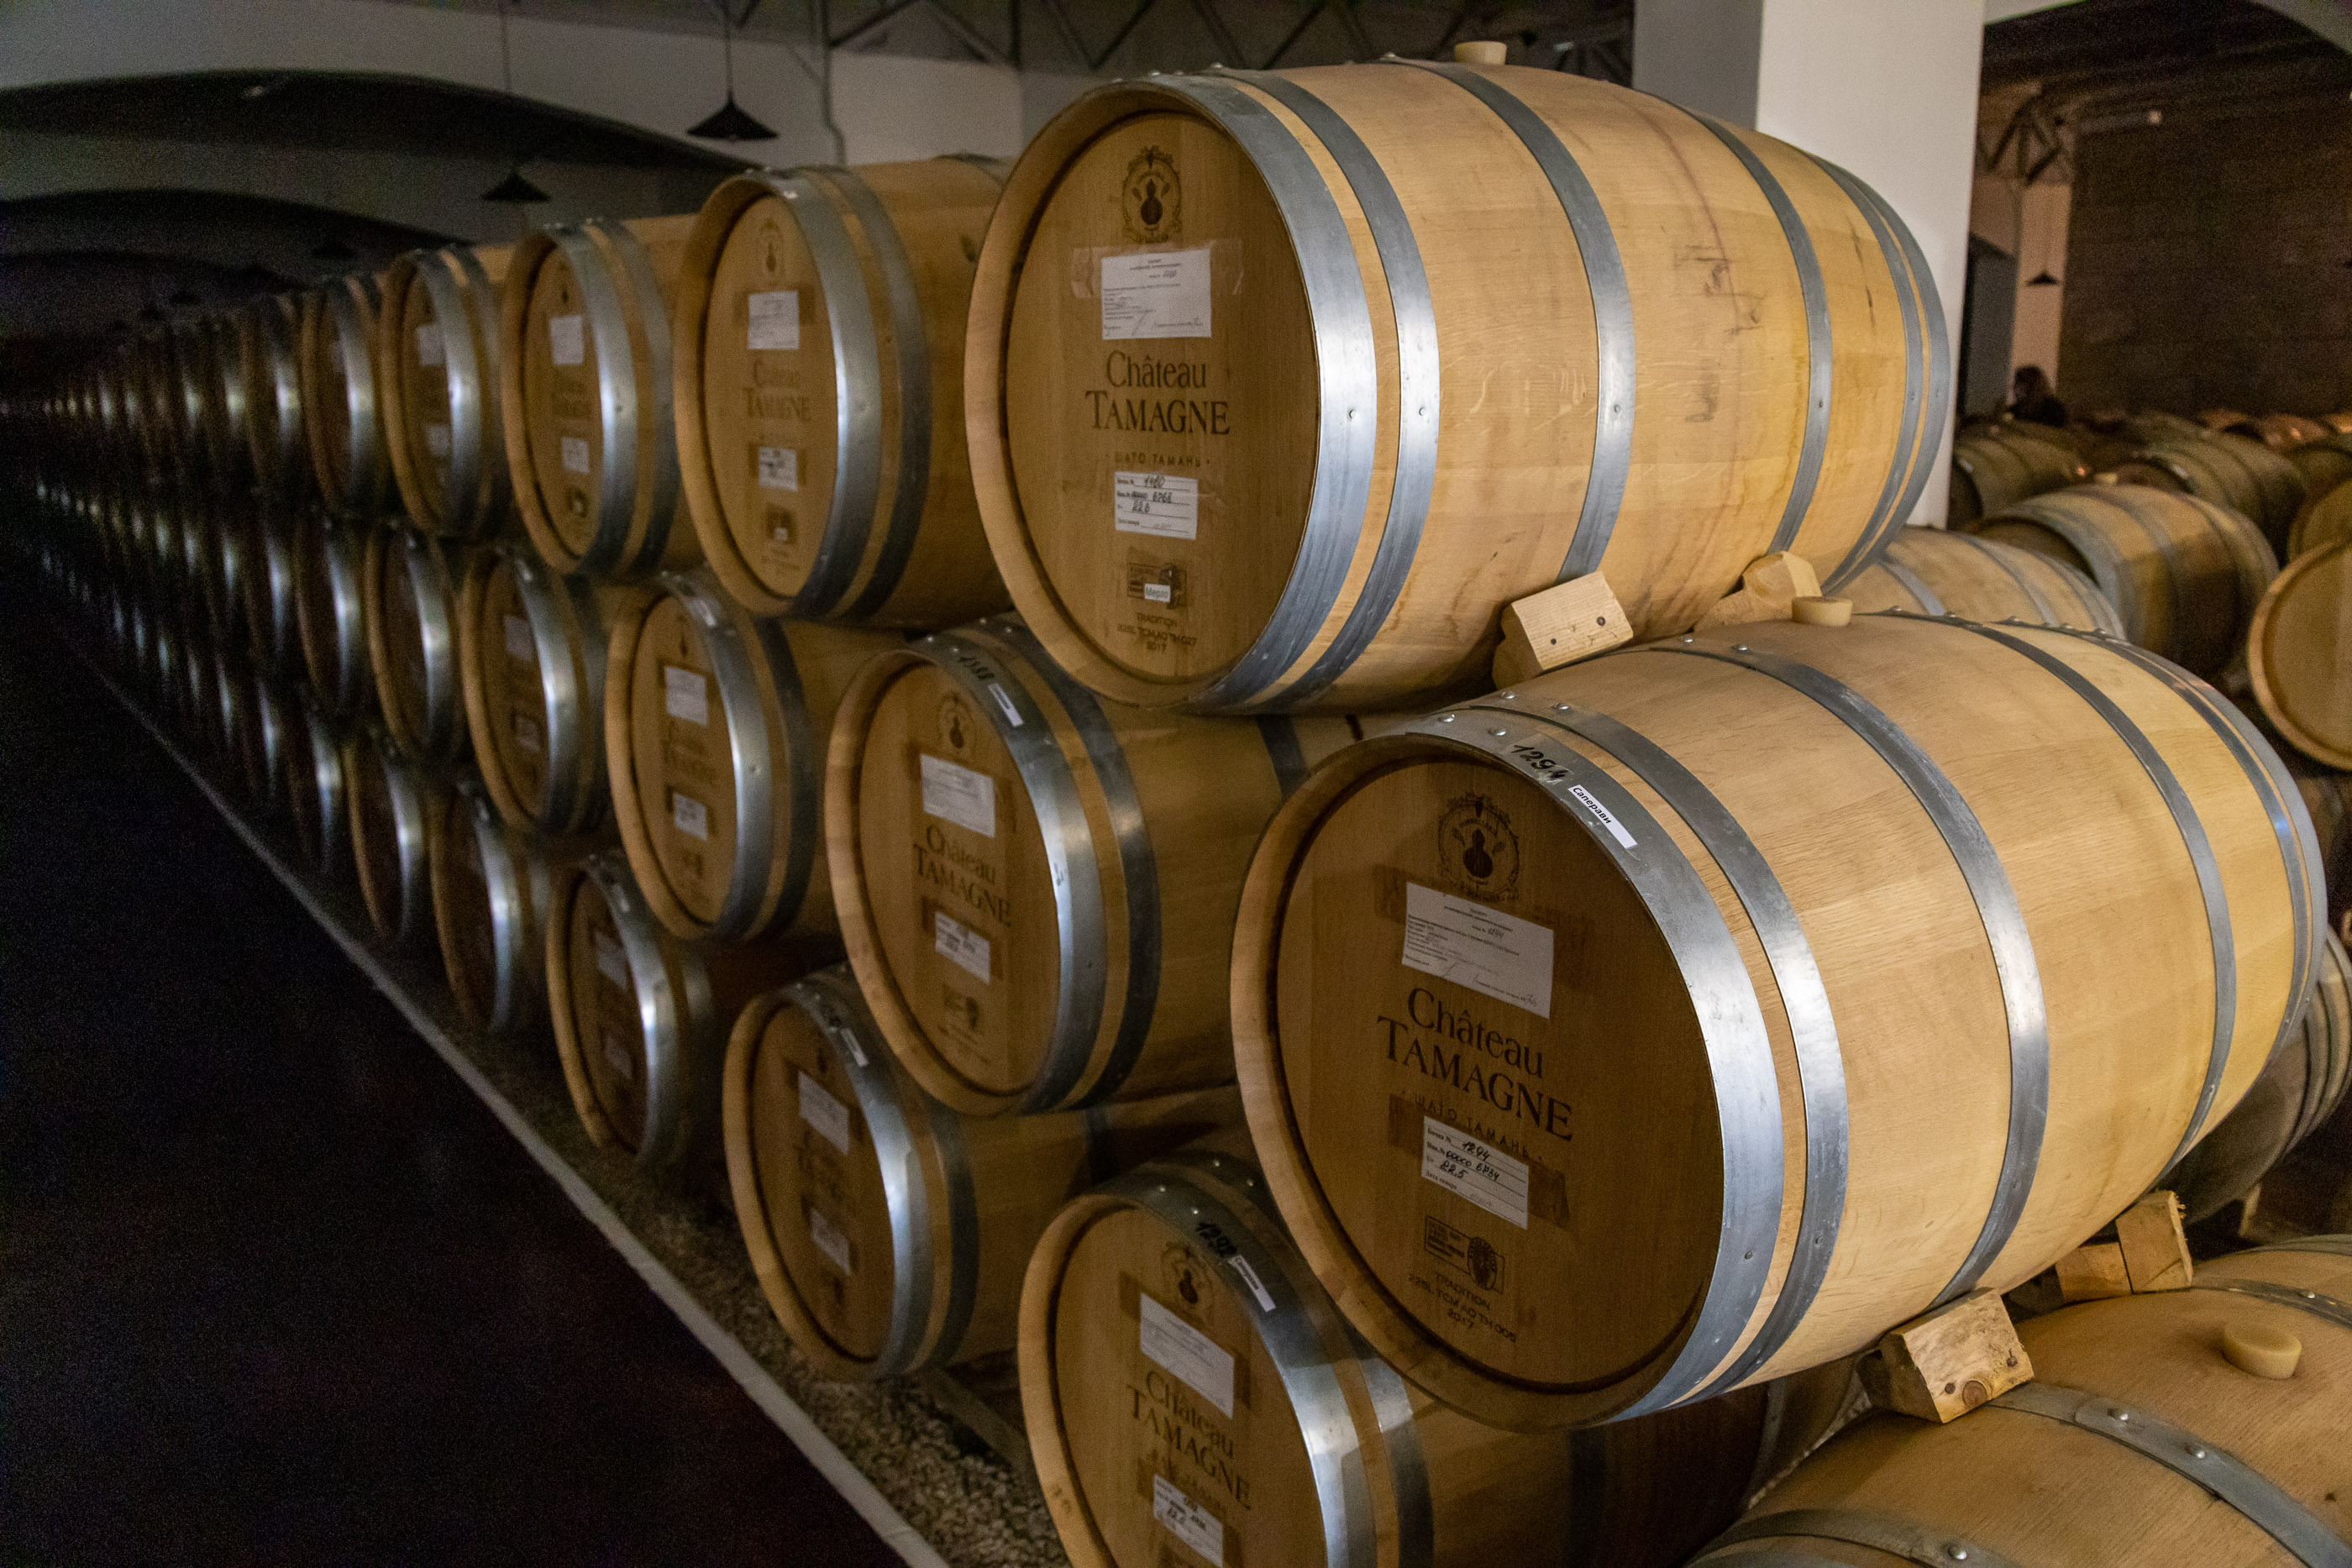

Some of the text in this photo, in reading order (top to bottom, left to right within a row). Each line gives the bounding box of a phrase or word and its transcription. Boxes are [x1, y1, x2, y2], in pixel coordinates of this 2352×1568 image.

[1106, 350, 1206, 388] Château
[1084, 390, 1230, 435] TAMAGNE
[1572, 787, 1612, 825] Саперави
[1408, 988, 1542, 1078] Château
[1376, 1015, 1573, 1141] TAMAGNE
[1126, 1384, 1251, 1510] TAMAGNE
